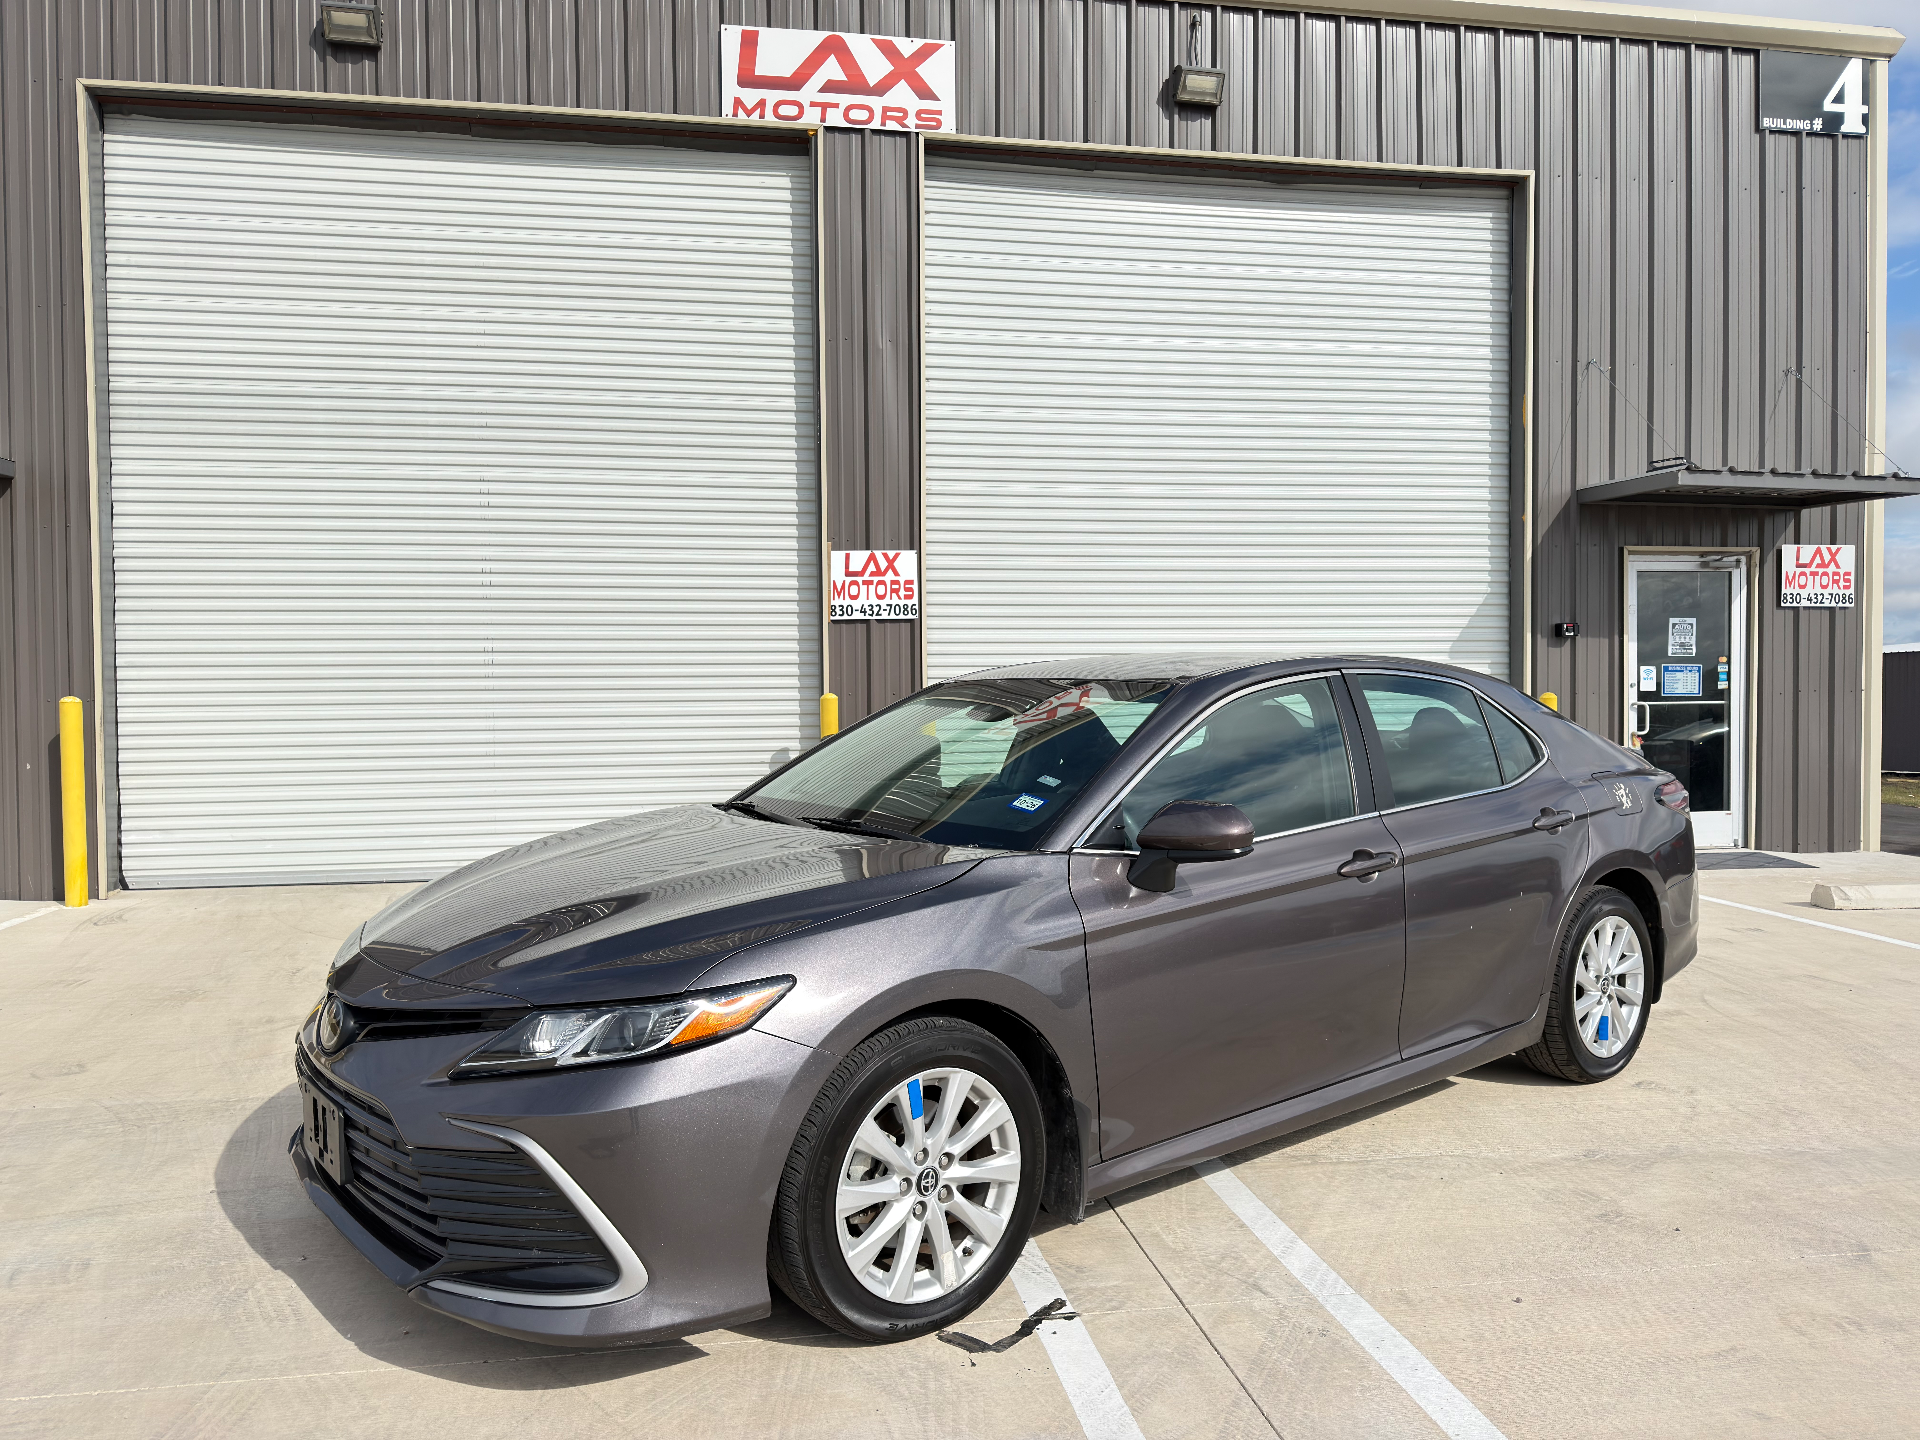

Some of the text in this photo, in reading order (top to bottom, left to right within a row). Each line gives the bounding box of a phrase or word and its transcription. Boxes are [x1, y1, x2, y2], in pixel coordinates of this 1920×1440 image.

[737, 29, 946, 101] LAX
[1763, 57, 1868, 134] BUILDING # 4
[732, 96, 943, 130] MOTORS
[845, 552, 901, 577] LAX
[1795, 546, 1842, 569] LAX
[832, 579, 915, 601] MOTORS
[1785, 570, 1852, 590] MOTORS
[830, 603, 918, 617] 830-432-7086
[1781, 592, 1854, 605] 830-432-7086
